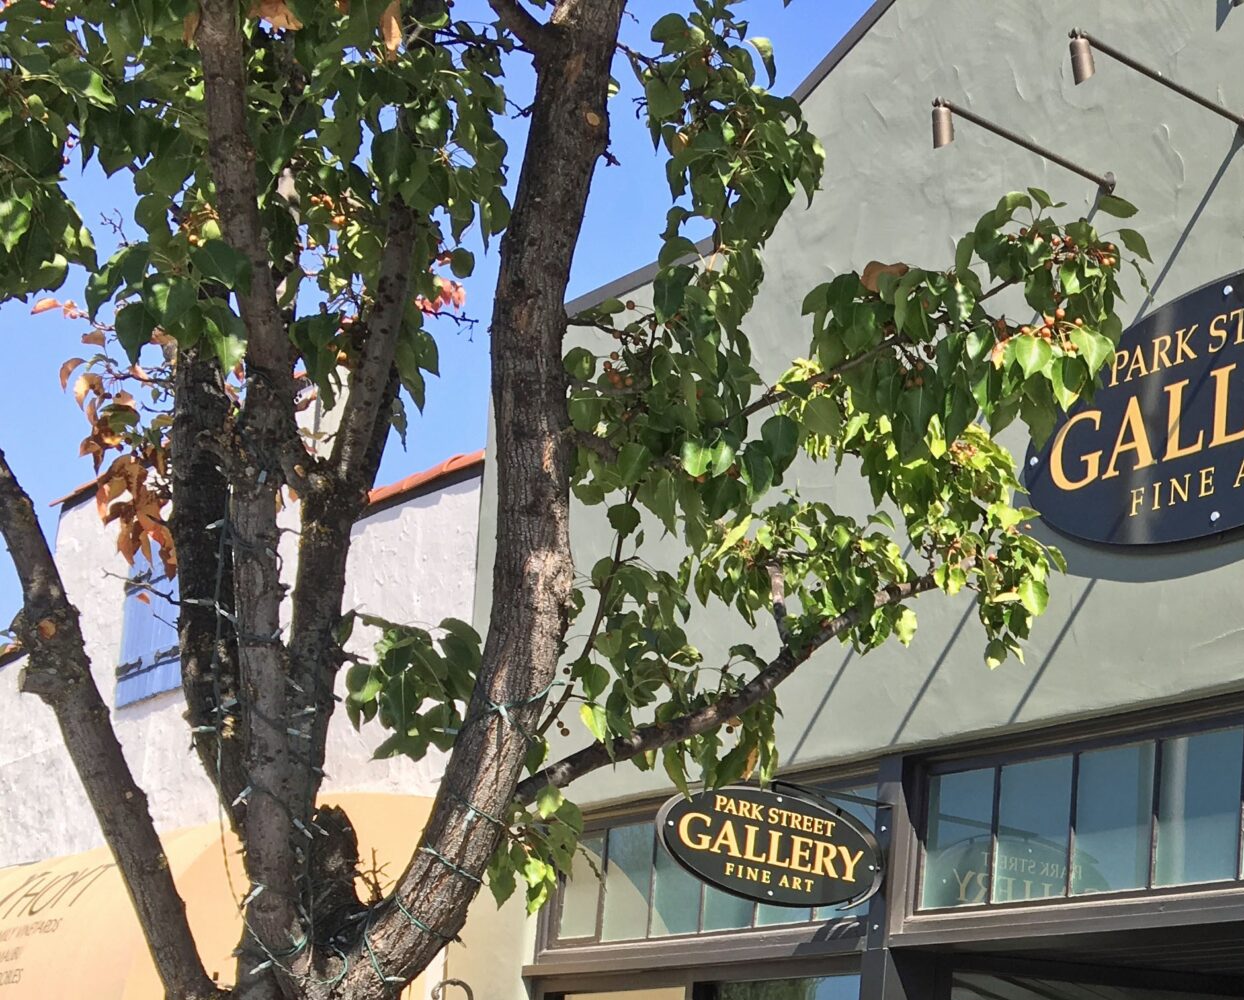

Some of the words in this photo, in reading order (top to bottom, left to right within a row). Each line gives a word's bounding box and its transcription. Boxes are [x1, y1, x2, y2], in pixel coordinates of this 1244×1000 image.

[1109, 325, 1199, 388] PARK
[1129, 467, 1215, 517] FINE
[715, 794, 764, 821] PARK
[768, 807, 836, 837] STREET
[677, 811, 864, 883] GALLERY
[725, 862, 771, 884] FINE
[779, 874, 815, 893] ART
